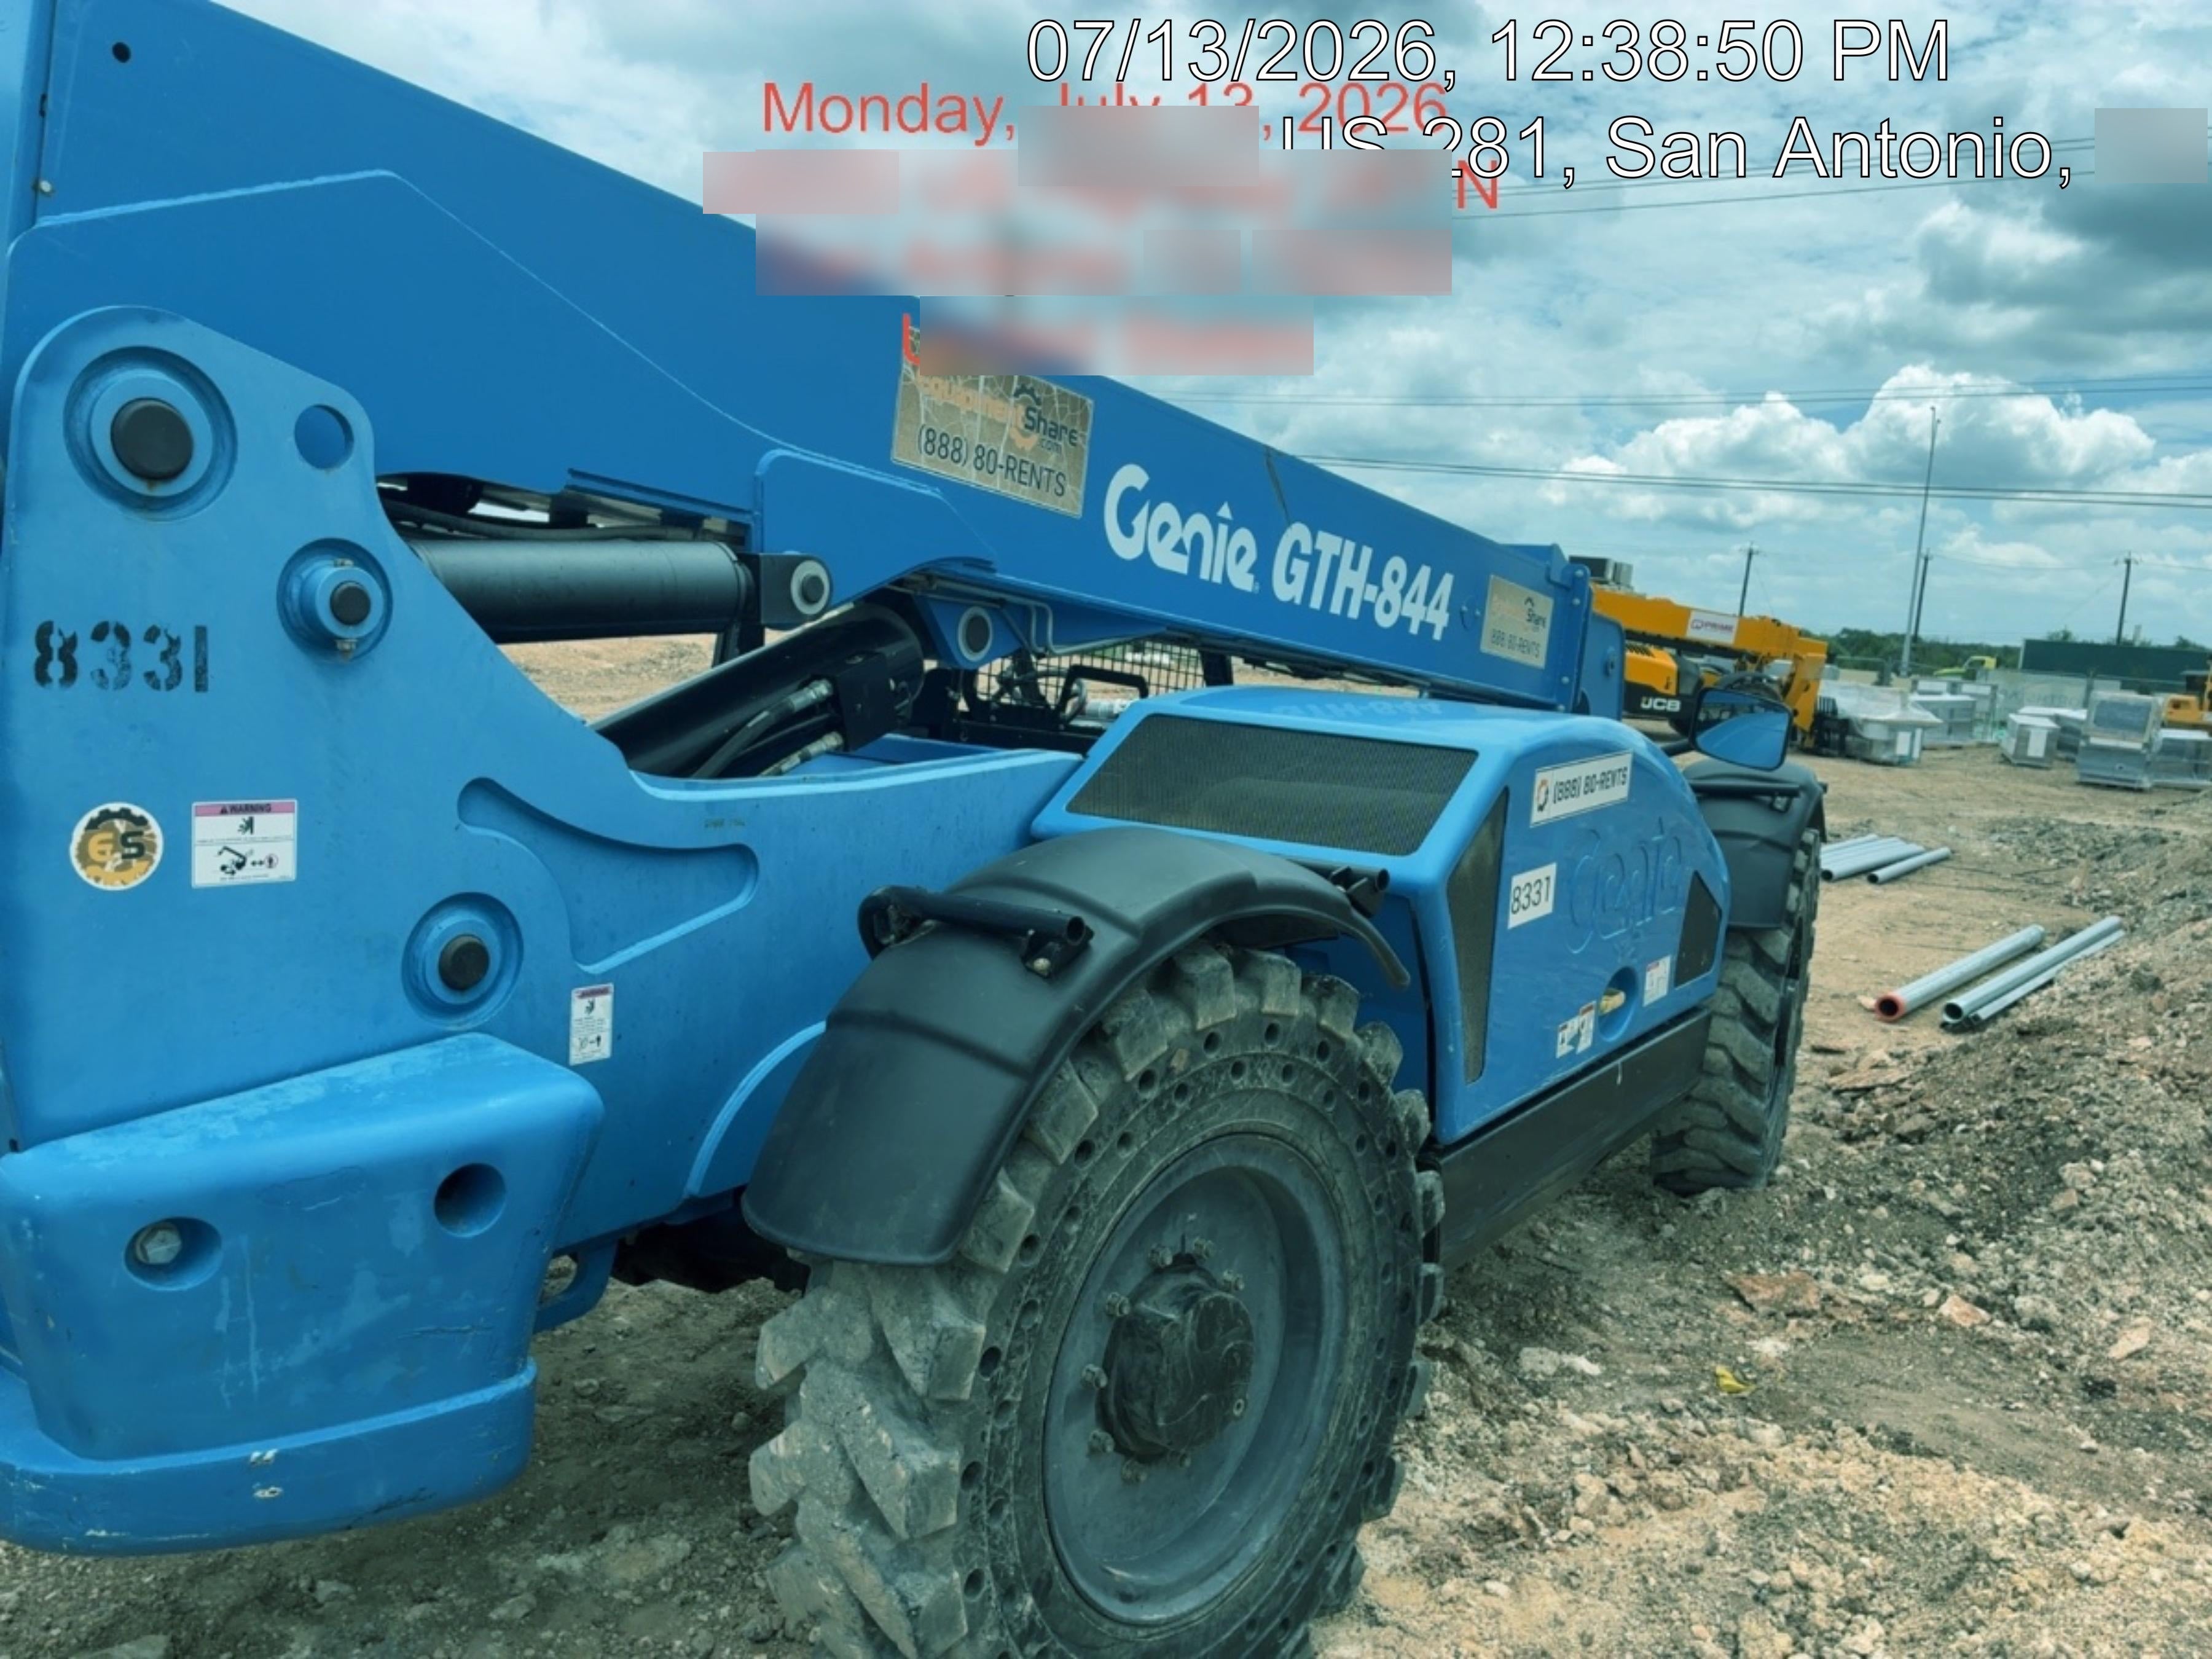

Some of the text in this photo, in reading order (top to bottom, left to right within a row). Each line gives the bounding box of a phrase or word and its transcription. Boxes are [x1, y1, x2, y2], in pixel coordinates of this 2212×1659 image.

[1024, 406, 1078, 447] Share
[918, 424, 1066, 497] (888) 80-RENTS
[1104, 463, 1454, 641] Genie GTH-844
[34, 620, 208, 692] 8331
[1640, 696, 1681, 712] JCB
[1510, 876, 1551, 916] 8331
